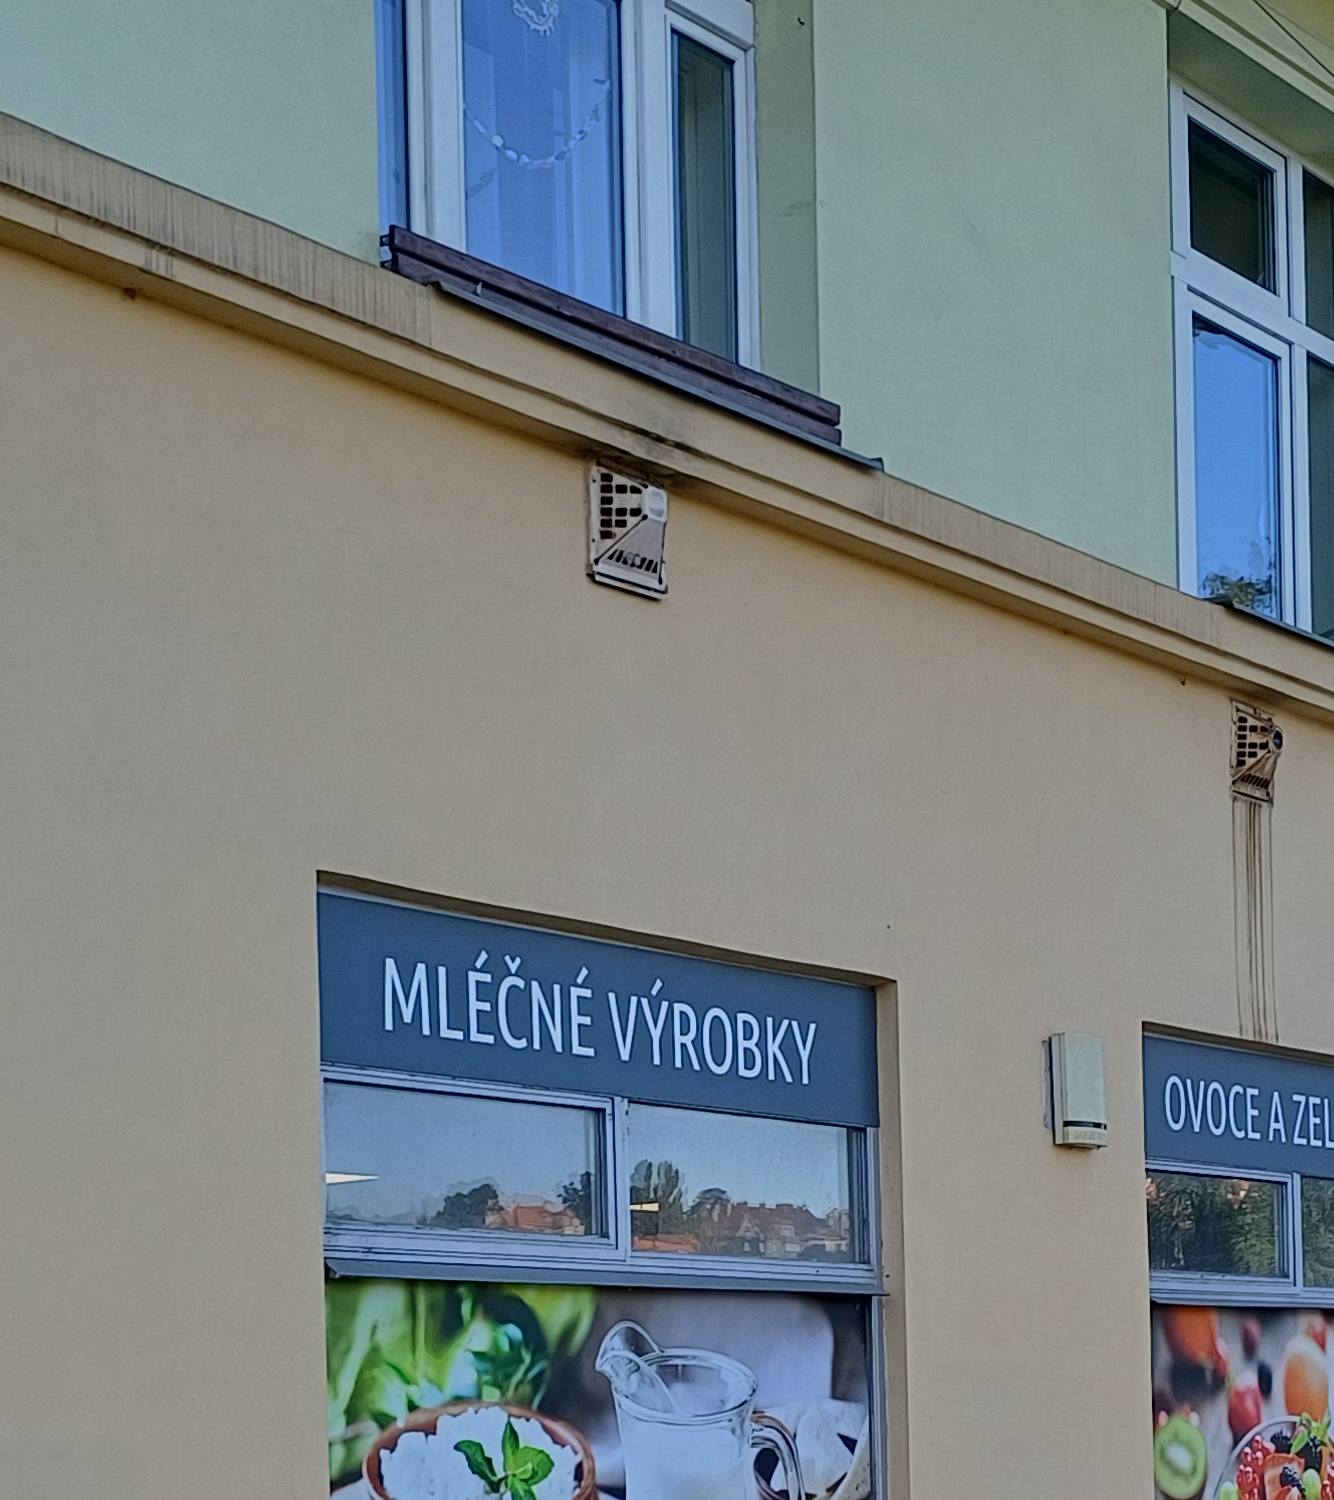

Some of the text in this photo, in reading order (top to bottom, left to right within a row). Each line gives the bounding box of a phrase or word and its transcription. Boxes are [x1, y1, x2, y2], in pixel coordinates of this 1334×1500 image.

[383, 949, 817, 1086] MLÉČNÉ VÝROBKY
[1165, 1075, 1261, 1141] OVOCE
[1268, 1091, 1287, 1143] A
